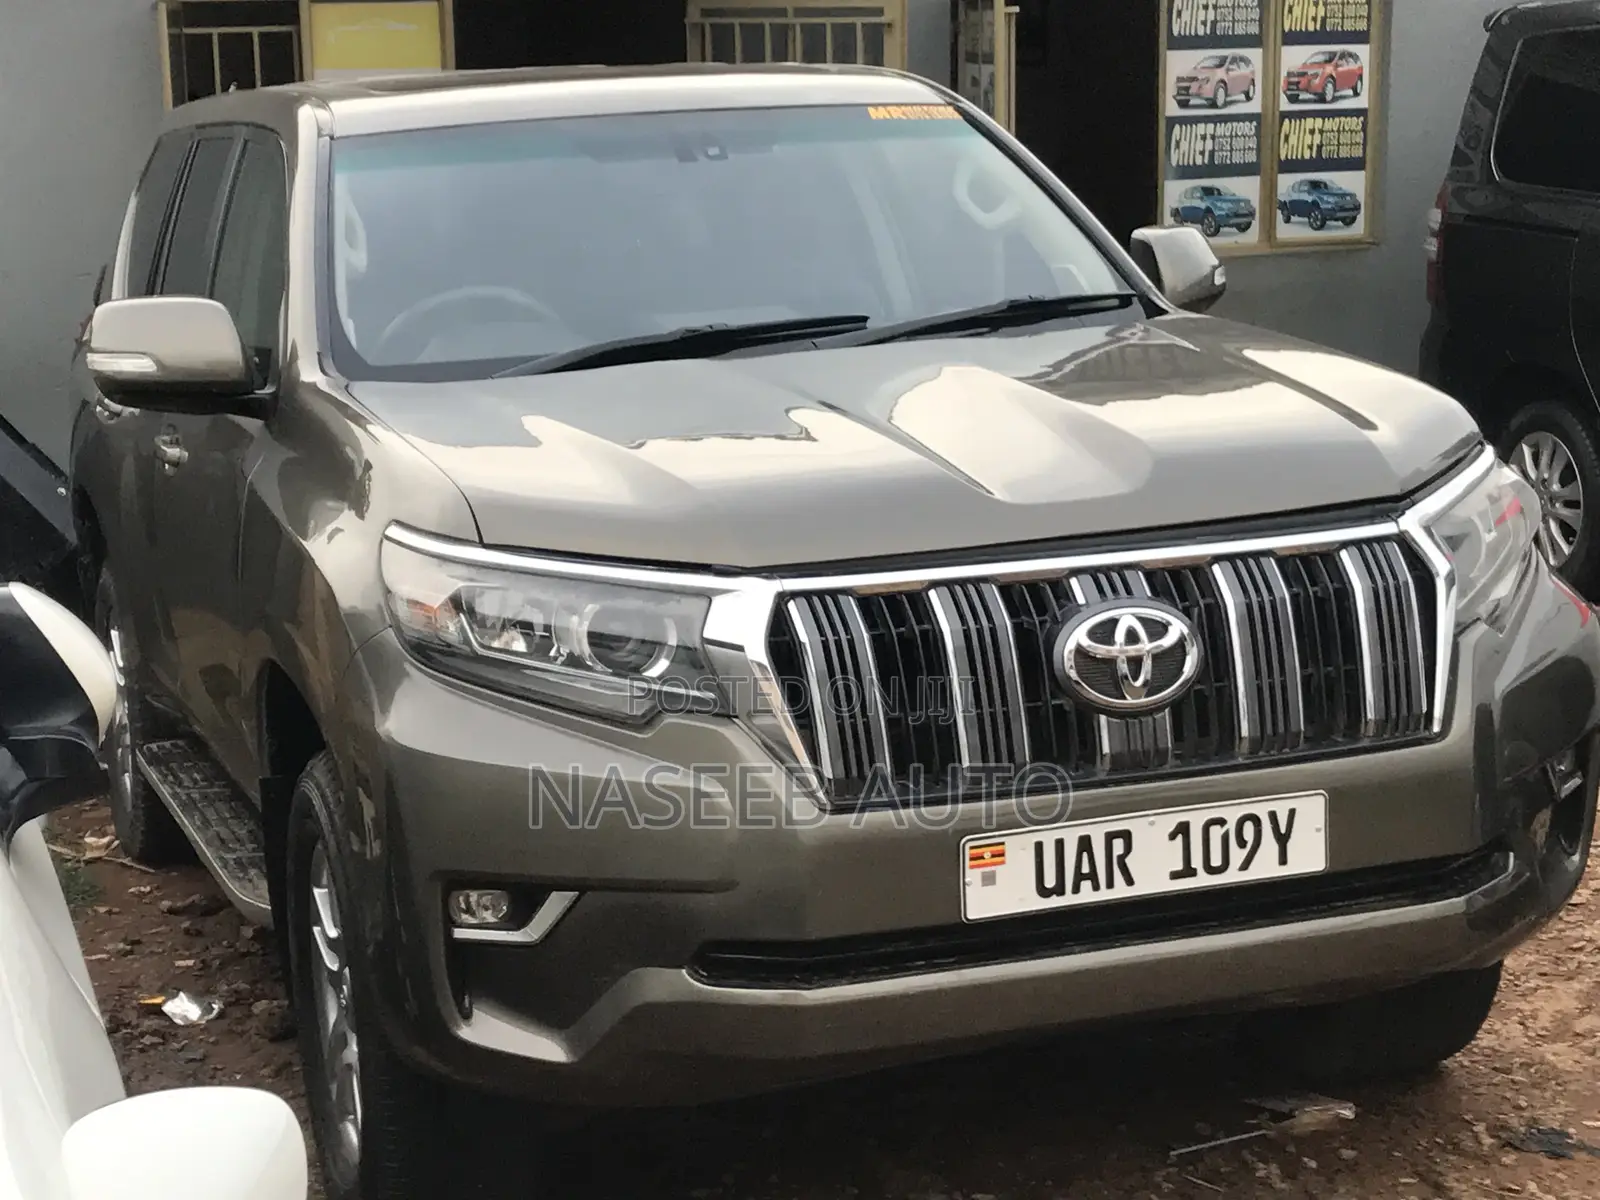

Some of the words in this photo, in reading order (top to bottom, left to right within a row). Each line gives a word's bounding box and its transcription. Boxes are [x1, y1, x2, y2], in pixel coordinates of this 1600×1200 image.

[1172, 0, 1215, 36] CHIEF
[1283, 0, 1325, 32] CHIEF
[1171, 123, 1214, 167] CHIEF
[1215, 121, 1258, 136] MOTORS
[1280, 117, 1323, 161] CHIEF
[1322, 116, 1364, 131] MOTORS
[1034, 828, 1136, 899] UAR
[1167, 807, 1297, 881] 109Y
